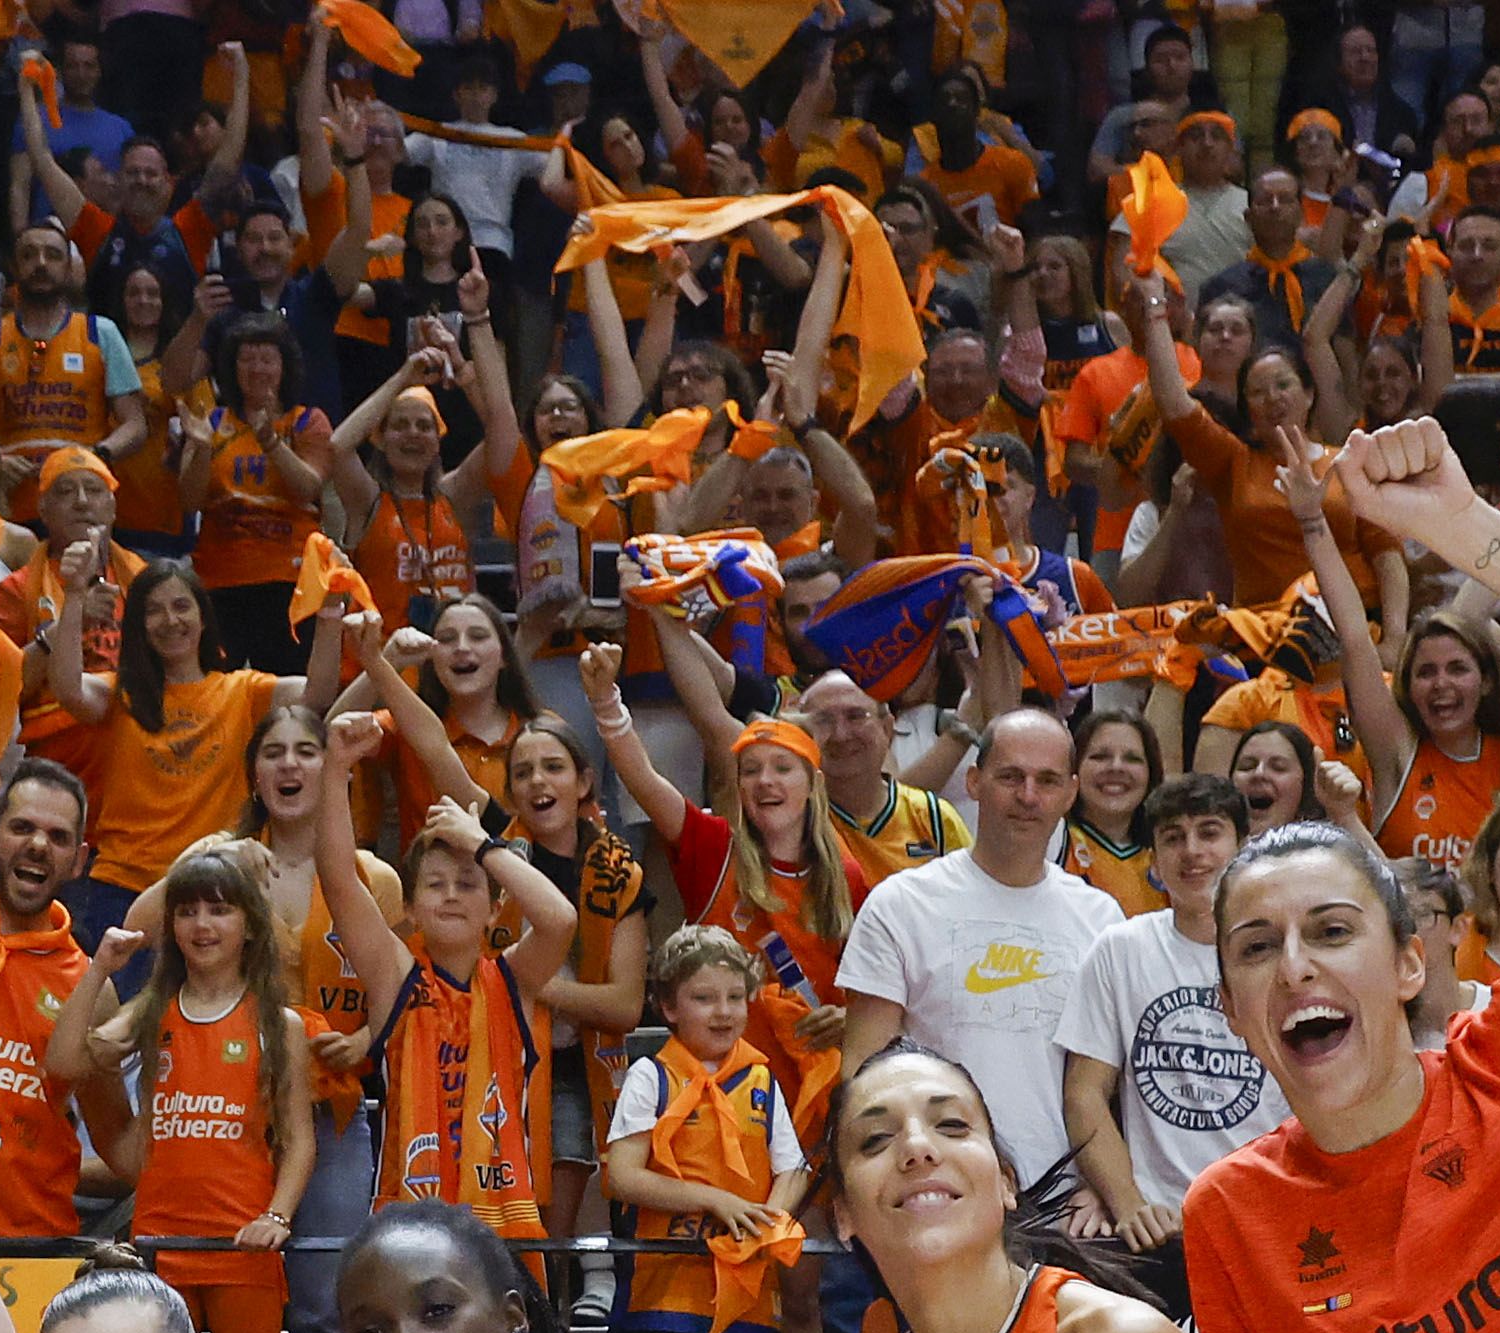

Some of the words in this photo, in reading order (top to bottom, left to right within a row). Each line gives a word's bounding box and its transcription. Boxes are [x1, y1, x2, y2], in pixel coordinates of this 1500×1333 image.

[233, 456, 267, 485] 14
[981, 943, 1045, 971] NIKE
[1137, 986, 1201, 1041] SUPERIOR
[1135, 1045, 1263, 1079] JACK&JONES
[152, 1091, 225, 1116] Cultura
[224, 1102, 245, 1117] del
[1225, 1074, 1262, 1123] GOODS
[152, 1116, 244, 1140] Esfuerzo
